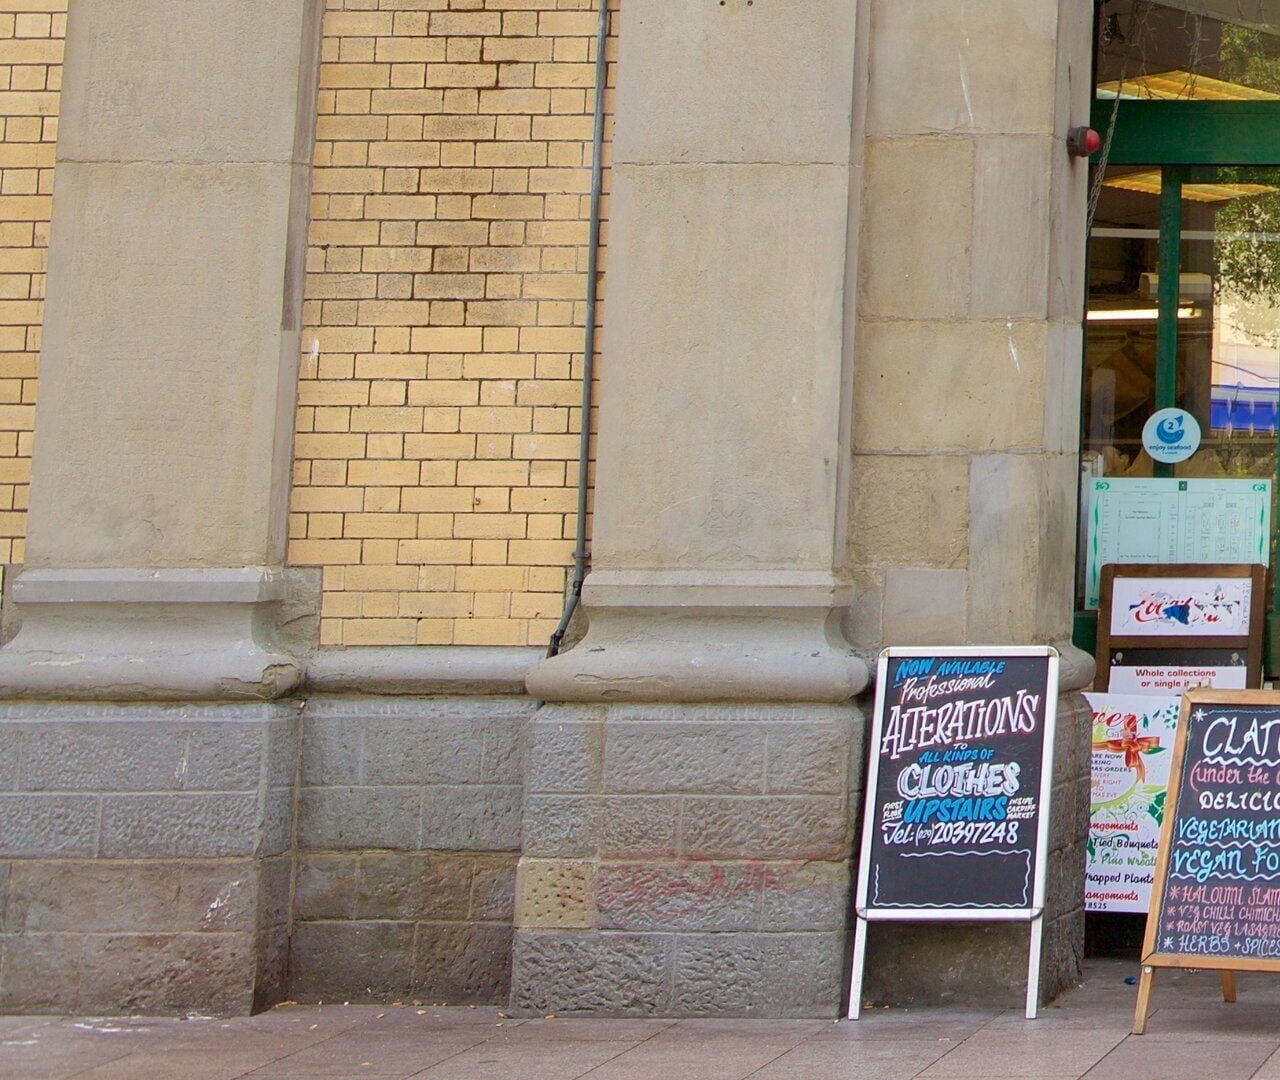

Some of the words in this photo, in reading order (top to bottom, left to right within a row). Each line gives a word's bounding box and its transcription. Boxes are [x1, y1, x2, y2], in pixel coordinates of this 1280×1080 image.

[1167, 421, 1174, 429] 2
[896, 658, 935, 679] NOW
[937, 661, 1006, 677] AVAILABLE
[1135, 669, 1165, 678] Whole
[1167, 669, 1216, 678] collections
[901, 672, 996, 704] Professional
[1154, 680, 1182, 689] single
[880, 689, 1040, 760] ALTERATIONS
[919, 750, 940, 763] ALL
[943, 749, 977, 762] KINDS
[980, 749, 994, 760] OF
[897, 761, 1020, 799] CLOTHES
[903, 796, 1008, 824] UPSTAIRS
[1116, 838, 1159, 851] Bouquets
[1173, 848, 1251, 882] VEGAN
[1124, 872, 1154, 884] Plants
[1182, 885, 1244, 905] HALOUMI
[1179, 934, 1230, 953] HERBS
